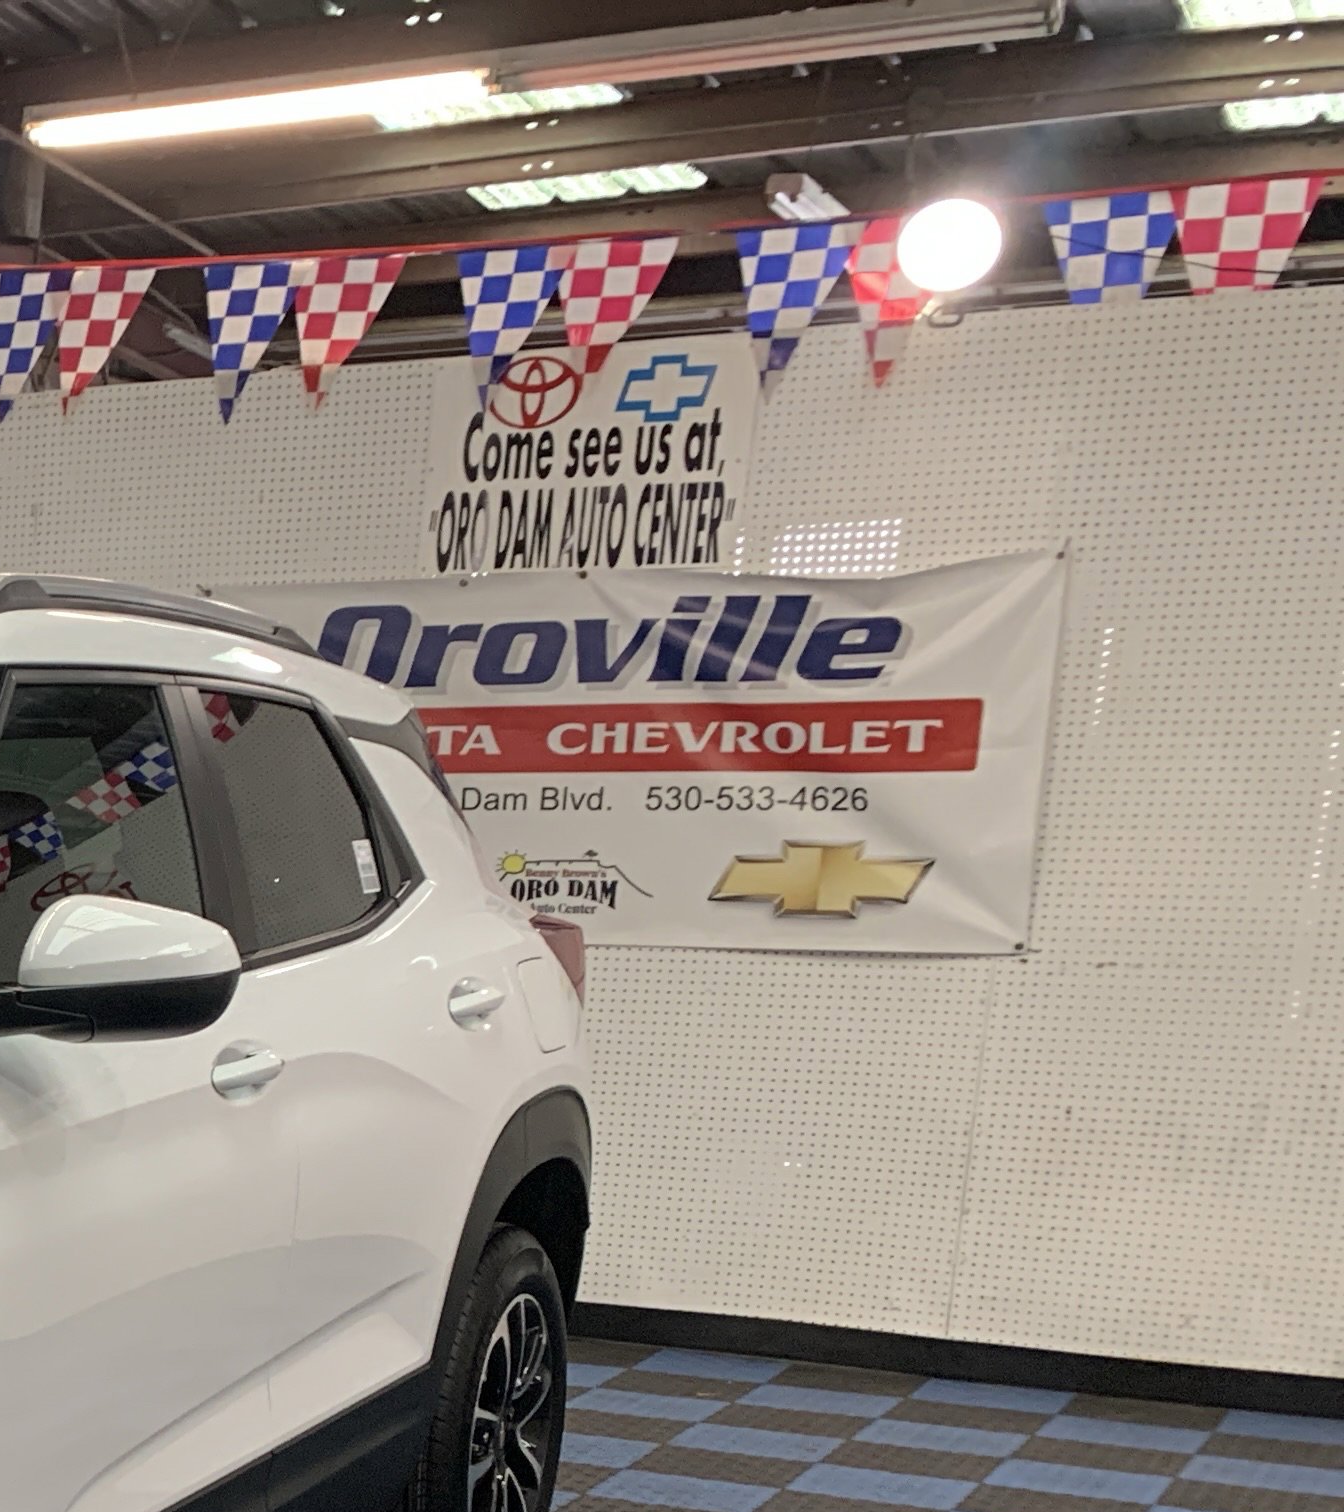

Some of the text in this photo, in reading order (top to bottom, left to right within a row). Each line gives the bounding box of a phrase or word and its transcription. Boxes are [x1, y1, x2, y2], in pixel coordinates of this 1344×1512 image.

[463, 407, 727, 482] Come see us at,
[493, 487, 555, 569] DAM
[555, 483, 628, 569] AUTO
[633, 481, 736, 567] CENTER"
[317, 594, 904, 689] Oroville
[545, 719, 943, 756] CHEVROLET
[462, 784, 869, 813] Dam Blvd. 530-533-4626
[510, 879, 618, 909] ORO DAM
[558, 903, 597, 914] Center
